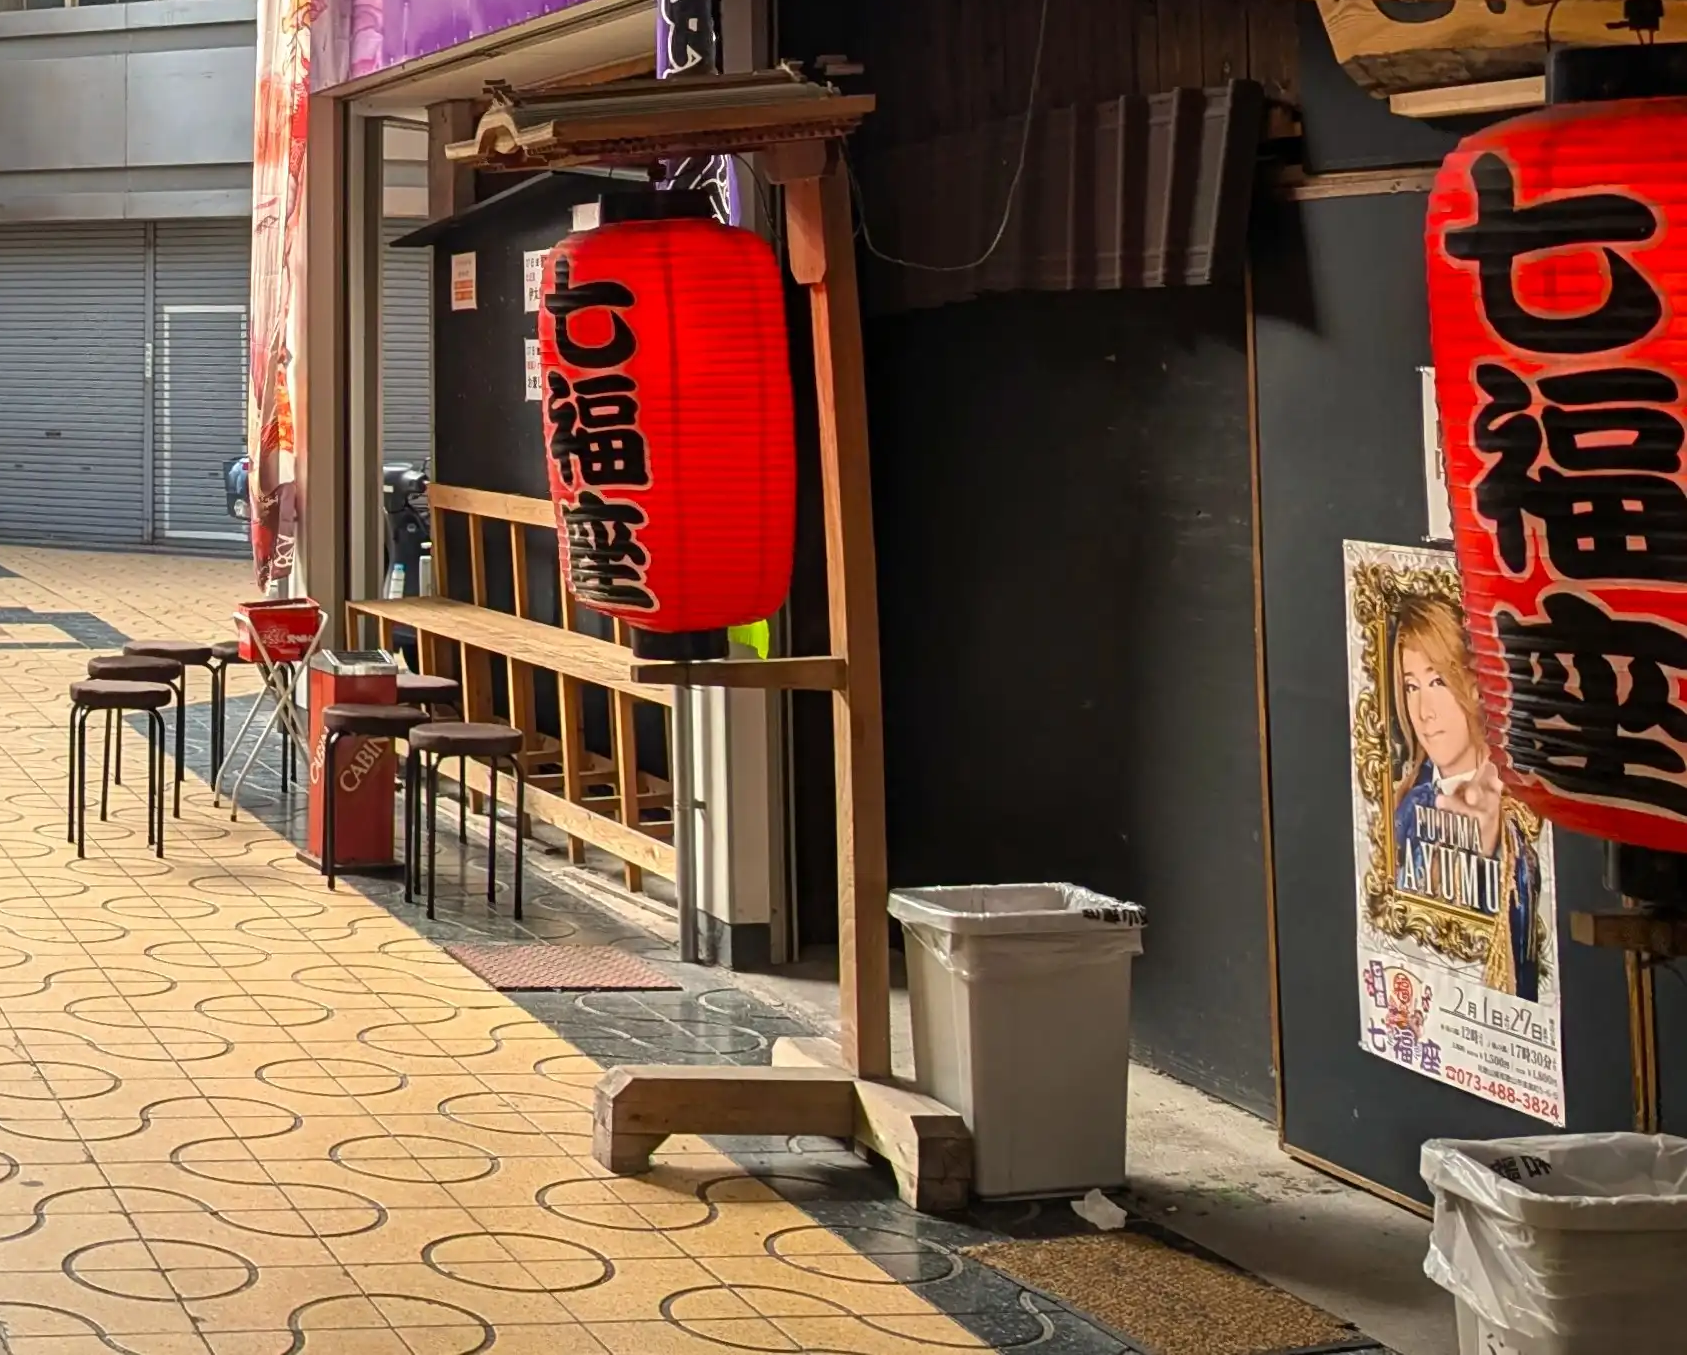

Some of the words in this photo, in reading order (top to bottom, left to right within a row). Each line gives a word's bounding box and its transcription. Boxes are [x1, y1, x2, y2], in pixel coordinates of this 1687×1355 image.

[544, 253, 660, 613] 七福座
[1444, 151, 1687, 818] 七福座
[1415, 804, 1482, 854] FUJIMA
[1403, 837, 1500, 913] AYUMU
[1367, 1017, 1442, 1076] 七福座
[1457, 1068, 1559, 1120] 073-488-3824
